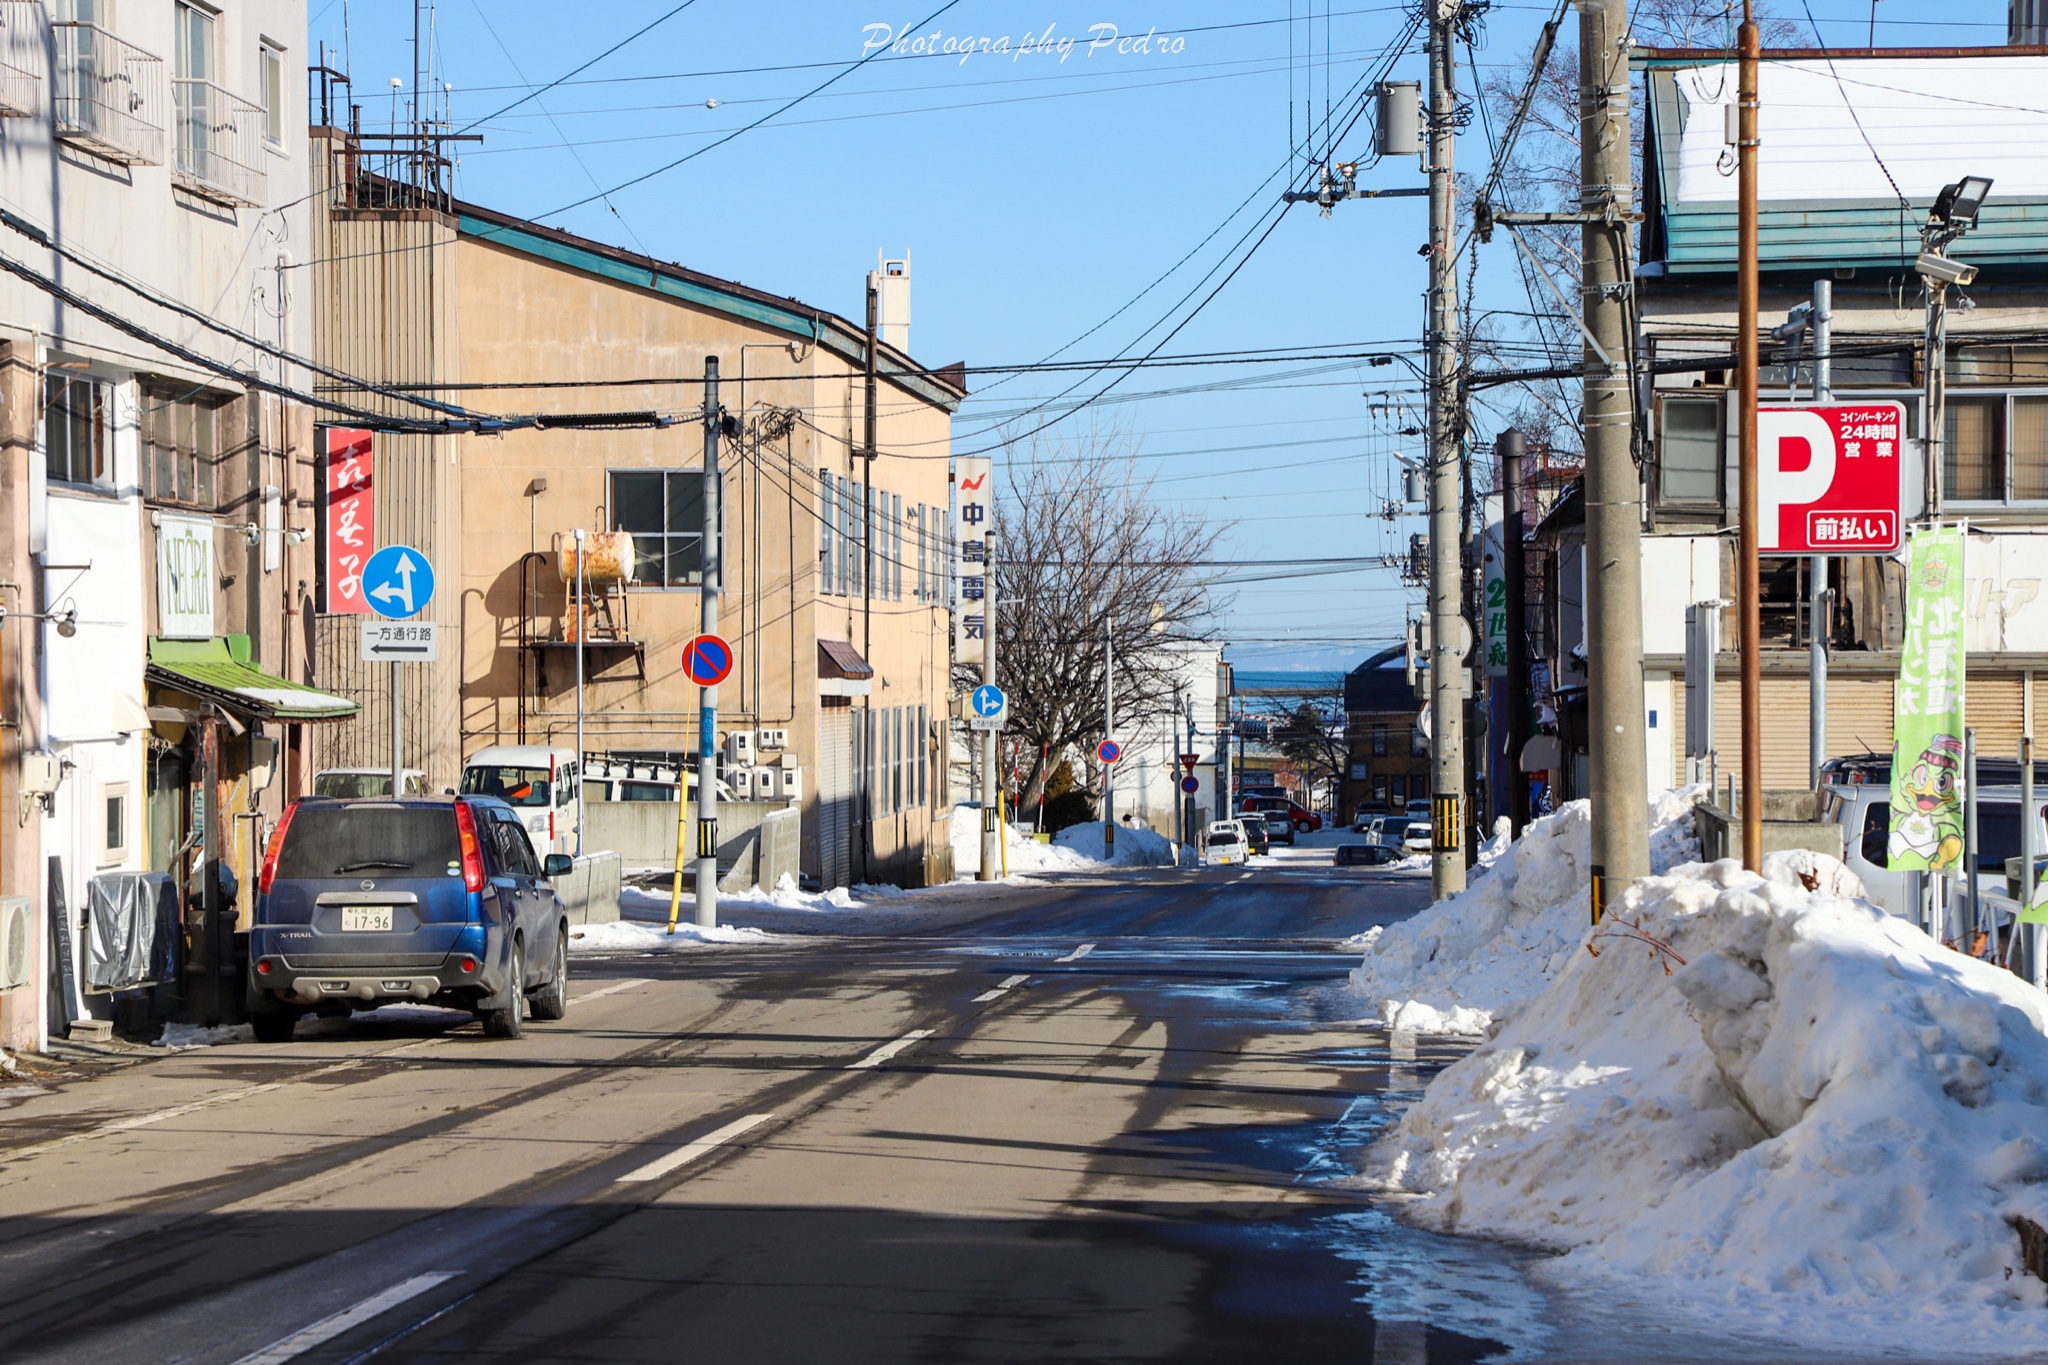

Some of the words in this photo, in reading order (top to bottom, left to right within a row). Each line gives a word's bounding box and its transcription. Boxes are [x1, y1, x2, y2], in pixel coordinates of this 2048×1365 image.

[1840, 424, 1897, 440] 24時間
[1757, 411, 1837, 548] P
[1815, 517, 1888, 541] 前払い
[166, 535, 210, 615] NEGRA
[962, 502, 984, 640] 中島電気
[366, 627, 432, 641] 一方通行路
[1487, 577, 1507, 667] 2世紀
[354, 916, 389, 929] 17-96
